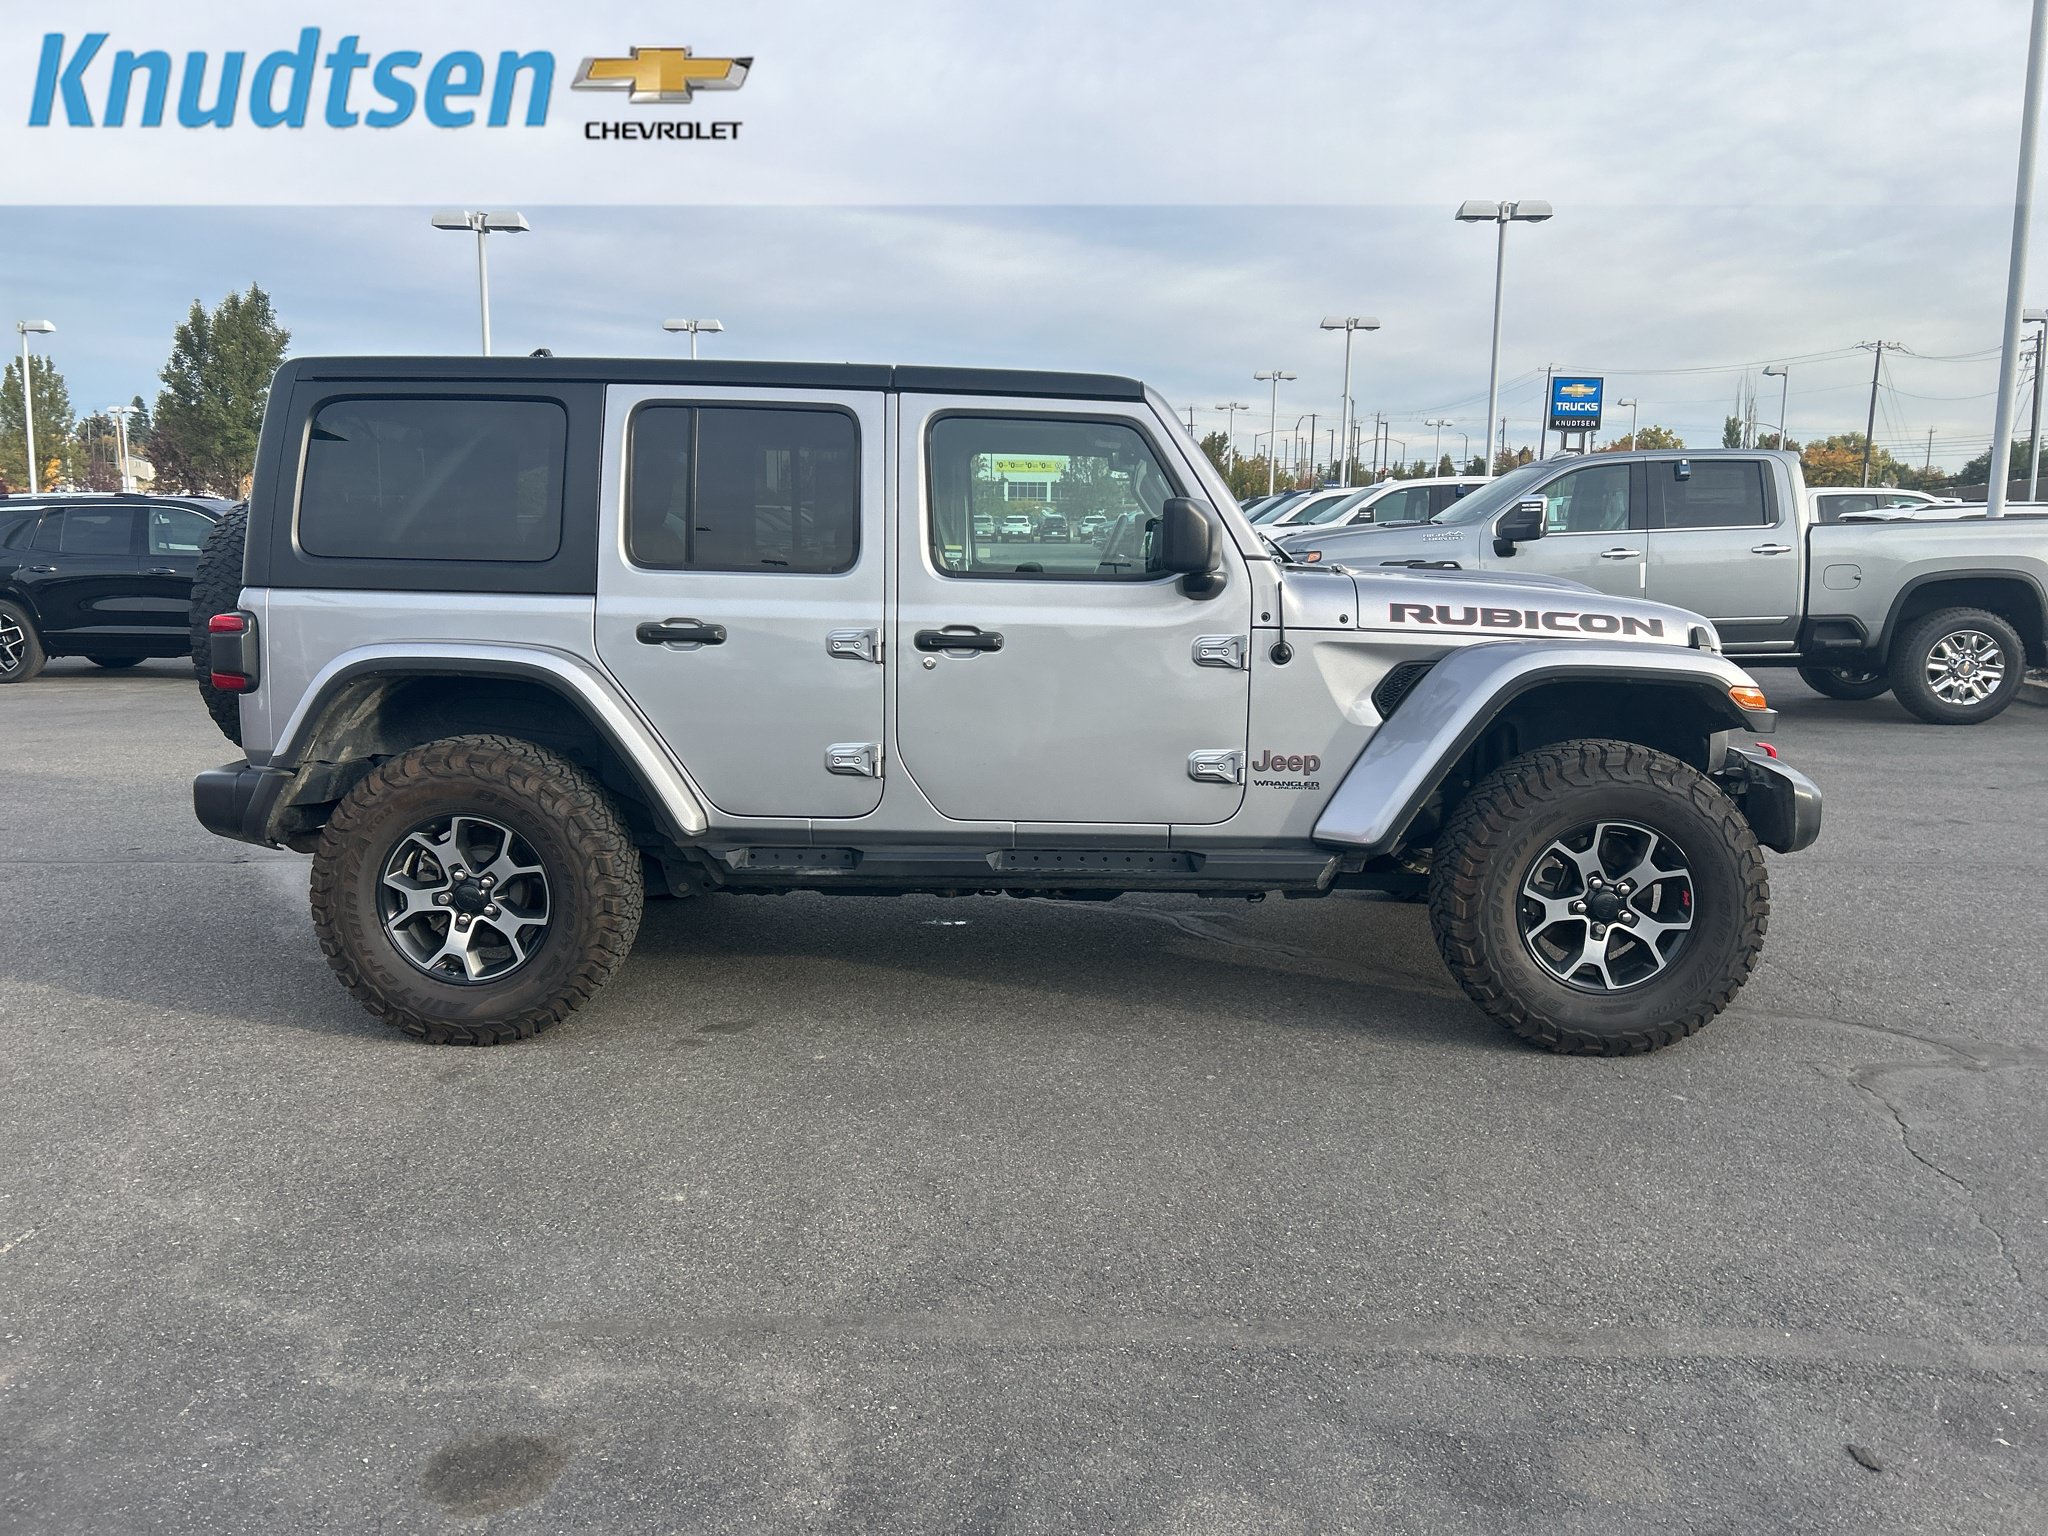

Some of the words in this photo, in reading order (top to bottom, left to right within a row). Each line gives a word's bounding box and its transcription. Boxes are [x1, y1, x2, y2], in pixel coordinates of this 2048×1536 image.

[1556, 402, 1599, 411] TRUCKS
[1389, 602, 1665, 638] RUBICON
[1252, 749, 1321, 776] Jeep
